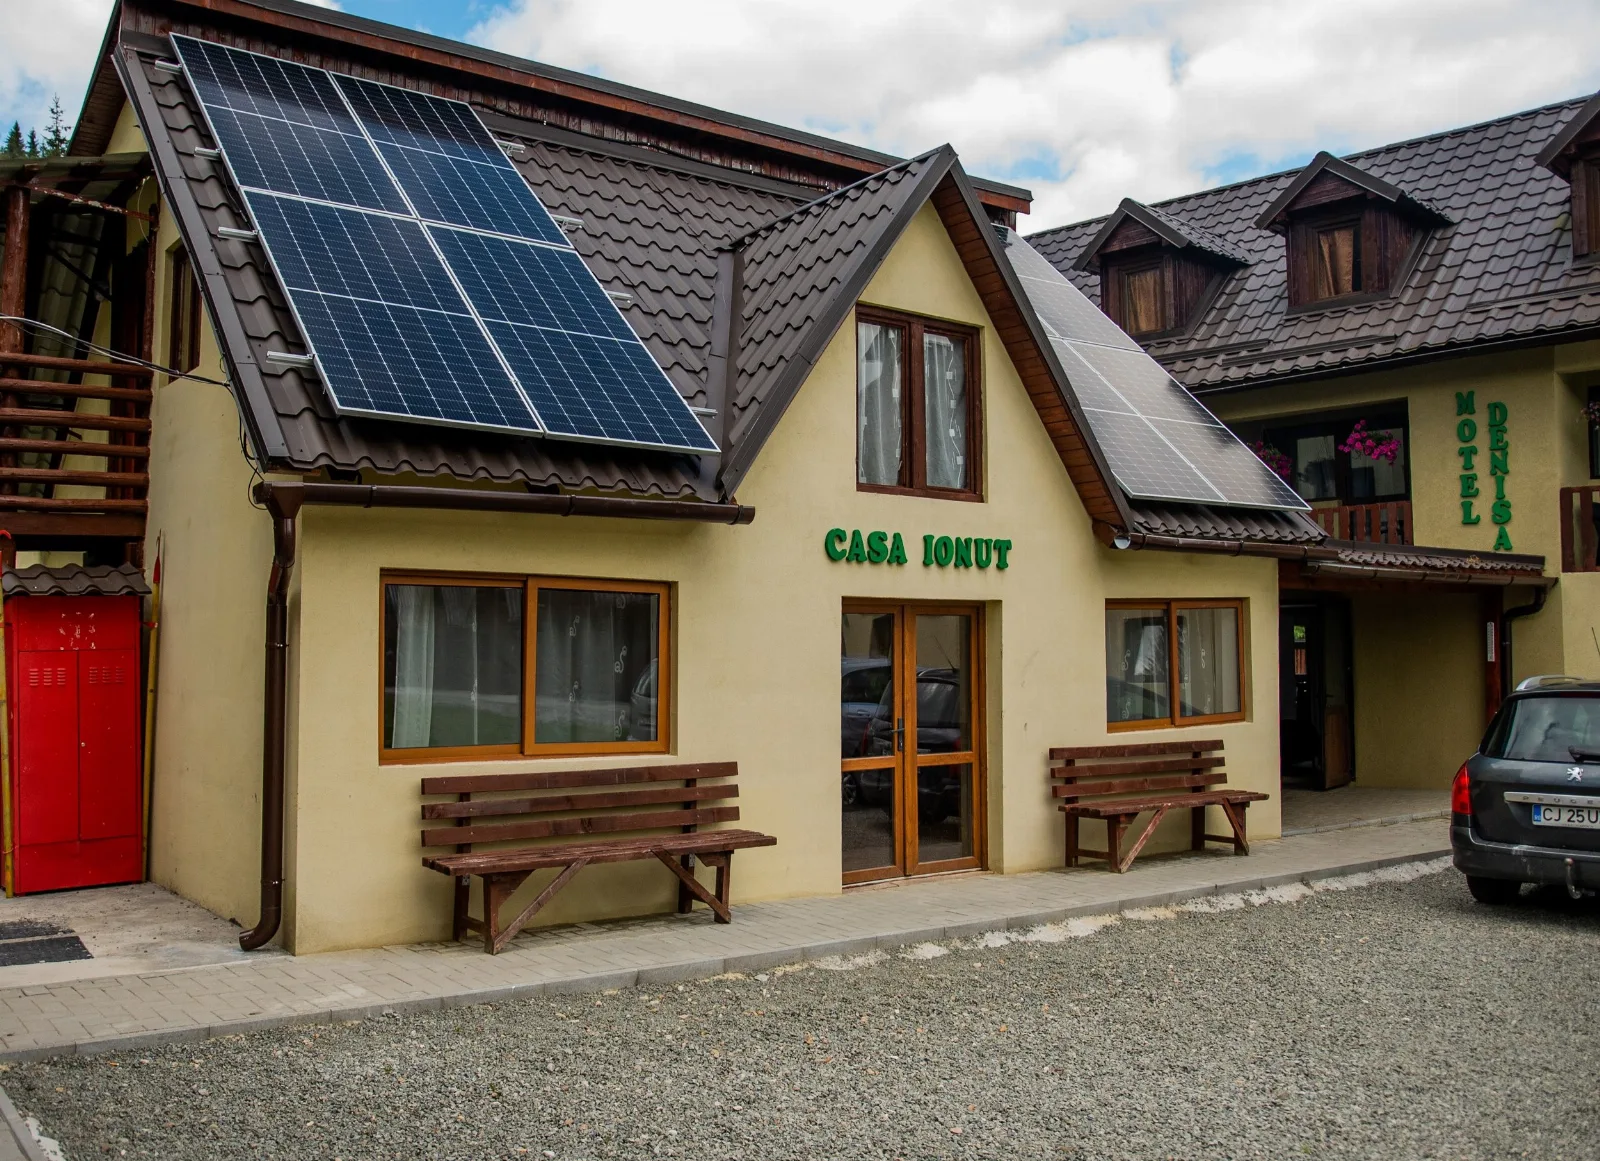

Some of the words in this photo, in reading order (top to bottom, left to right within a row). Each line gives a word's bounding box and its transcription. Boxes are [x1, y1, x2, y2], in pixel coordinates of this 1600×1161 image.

[1455, 390, 1481, 525] MOTEL
[1487, 401, 1513, 551] DENISA
[825, 528, 908, 564] CASA
[922, 534, 1012, 569] IONUT
[1543, 808, 1561, 821] CJ
[1567, 809, 1585, 823] 25
[1587, 810, 1600, 824] U
